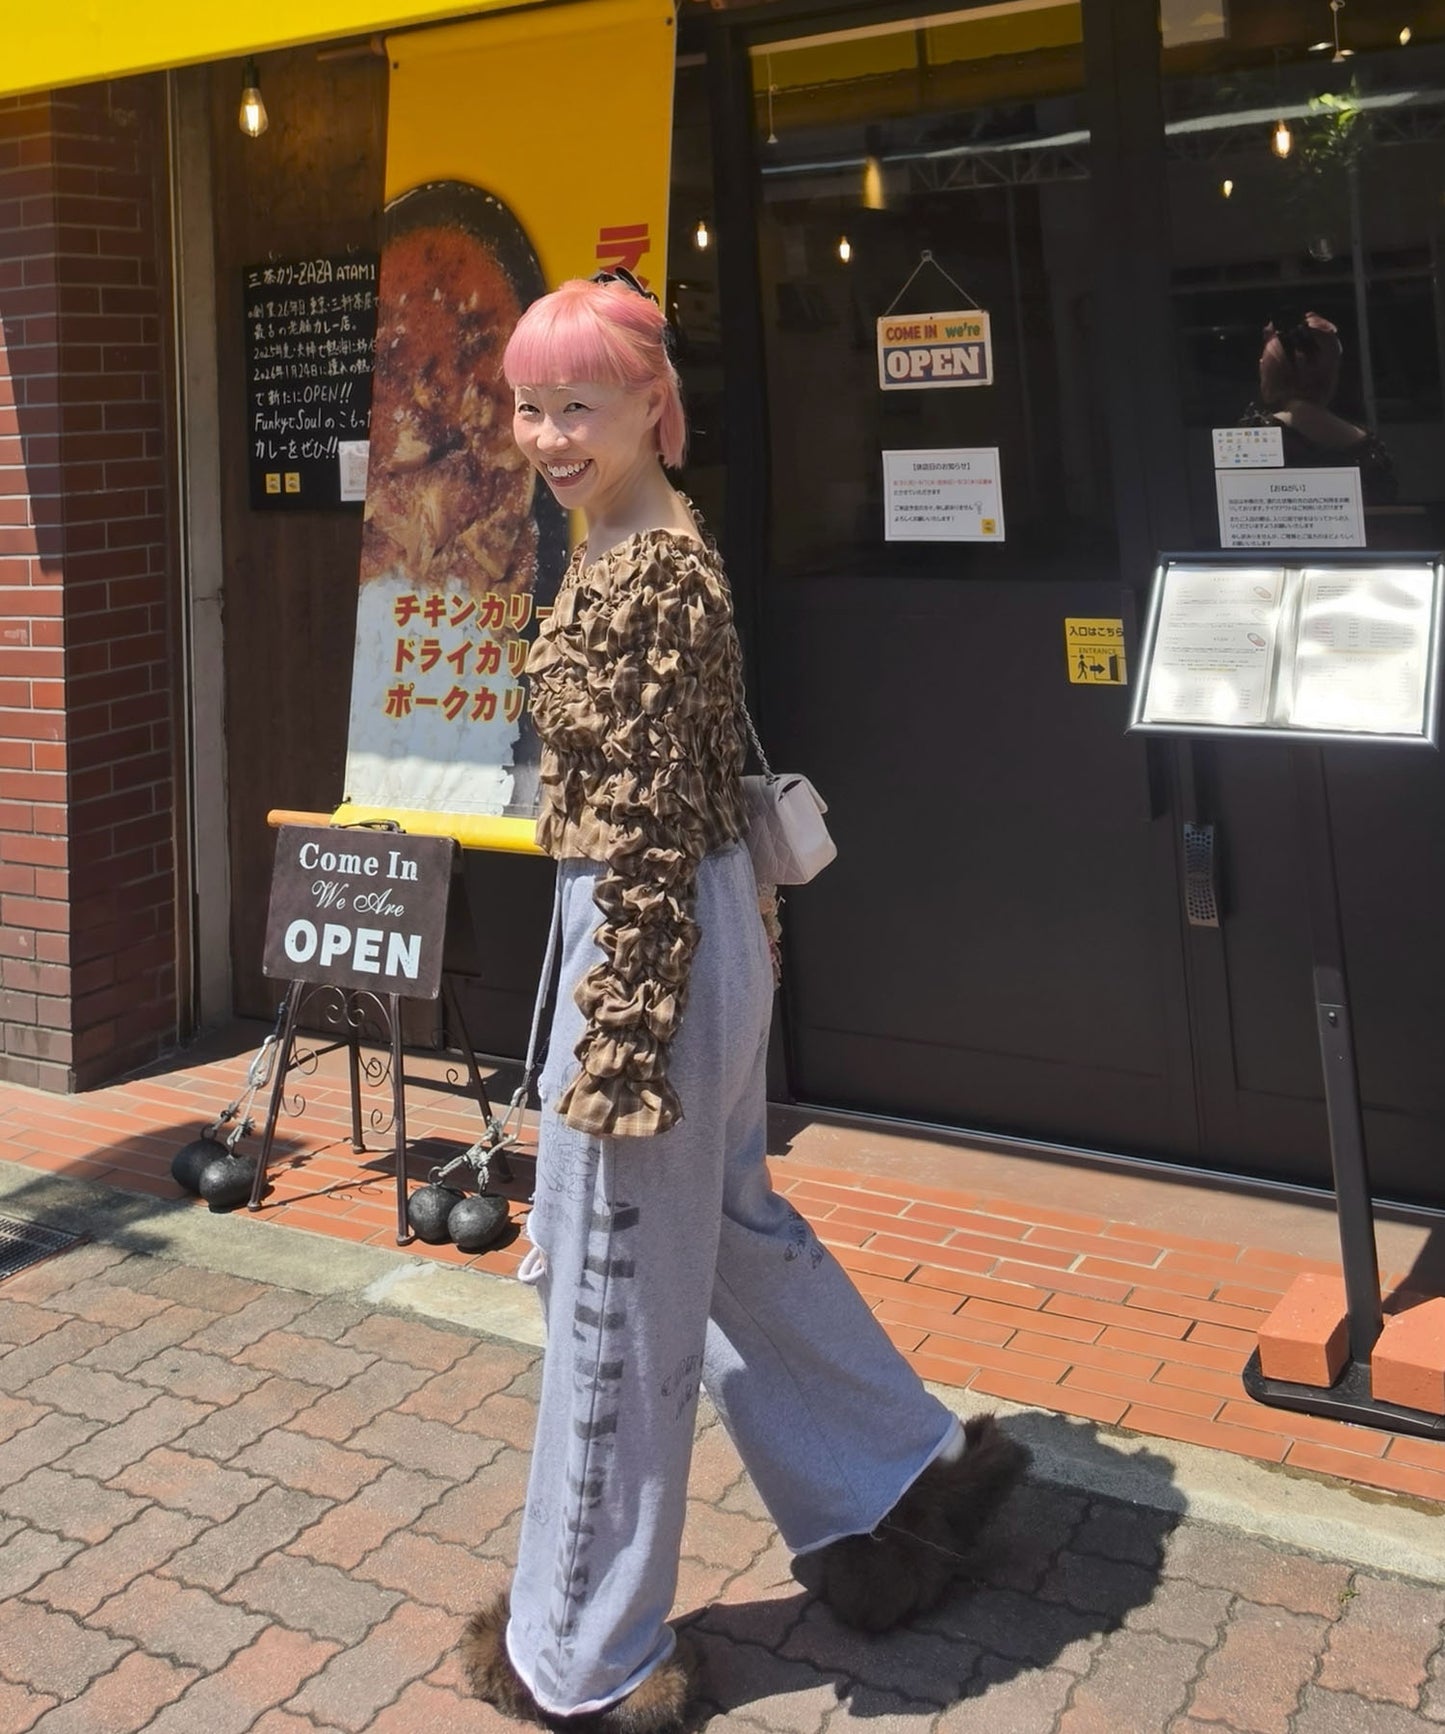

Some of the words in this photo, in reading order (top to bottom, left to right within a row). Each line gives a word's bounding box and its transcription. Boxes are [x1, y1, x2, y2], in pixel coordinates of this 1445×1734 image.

[336, 263, 376, 281] ATAMI
[886, 325, 921, 341] COME
[924, 324, 937, 340] IN
[945, 322, 981, 338] we're
[887, 346, 980, 379] OPEN
[393, 592, 556, 631] チキンカリー
[1069, 626, 1124, 638] 入口はこちら
[393, 638, 529, 679] ドライカリ
[1078, 647, 1116, 655] ENTRANCE
[384, 682, 533, 724] ポークカリ
[299, 842, 379, 877] Come
[386, 851, 419, 881] In
[311, 880, 349, 910] We
[353, 888, 406, 917] Are
[284, 918, 422, 979] OPEN
